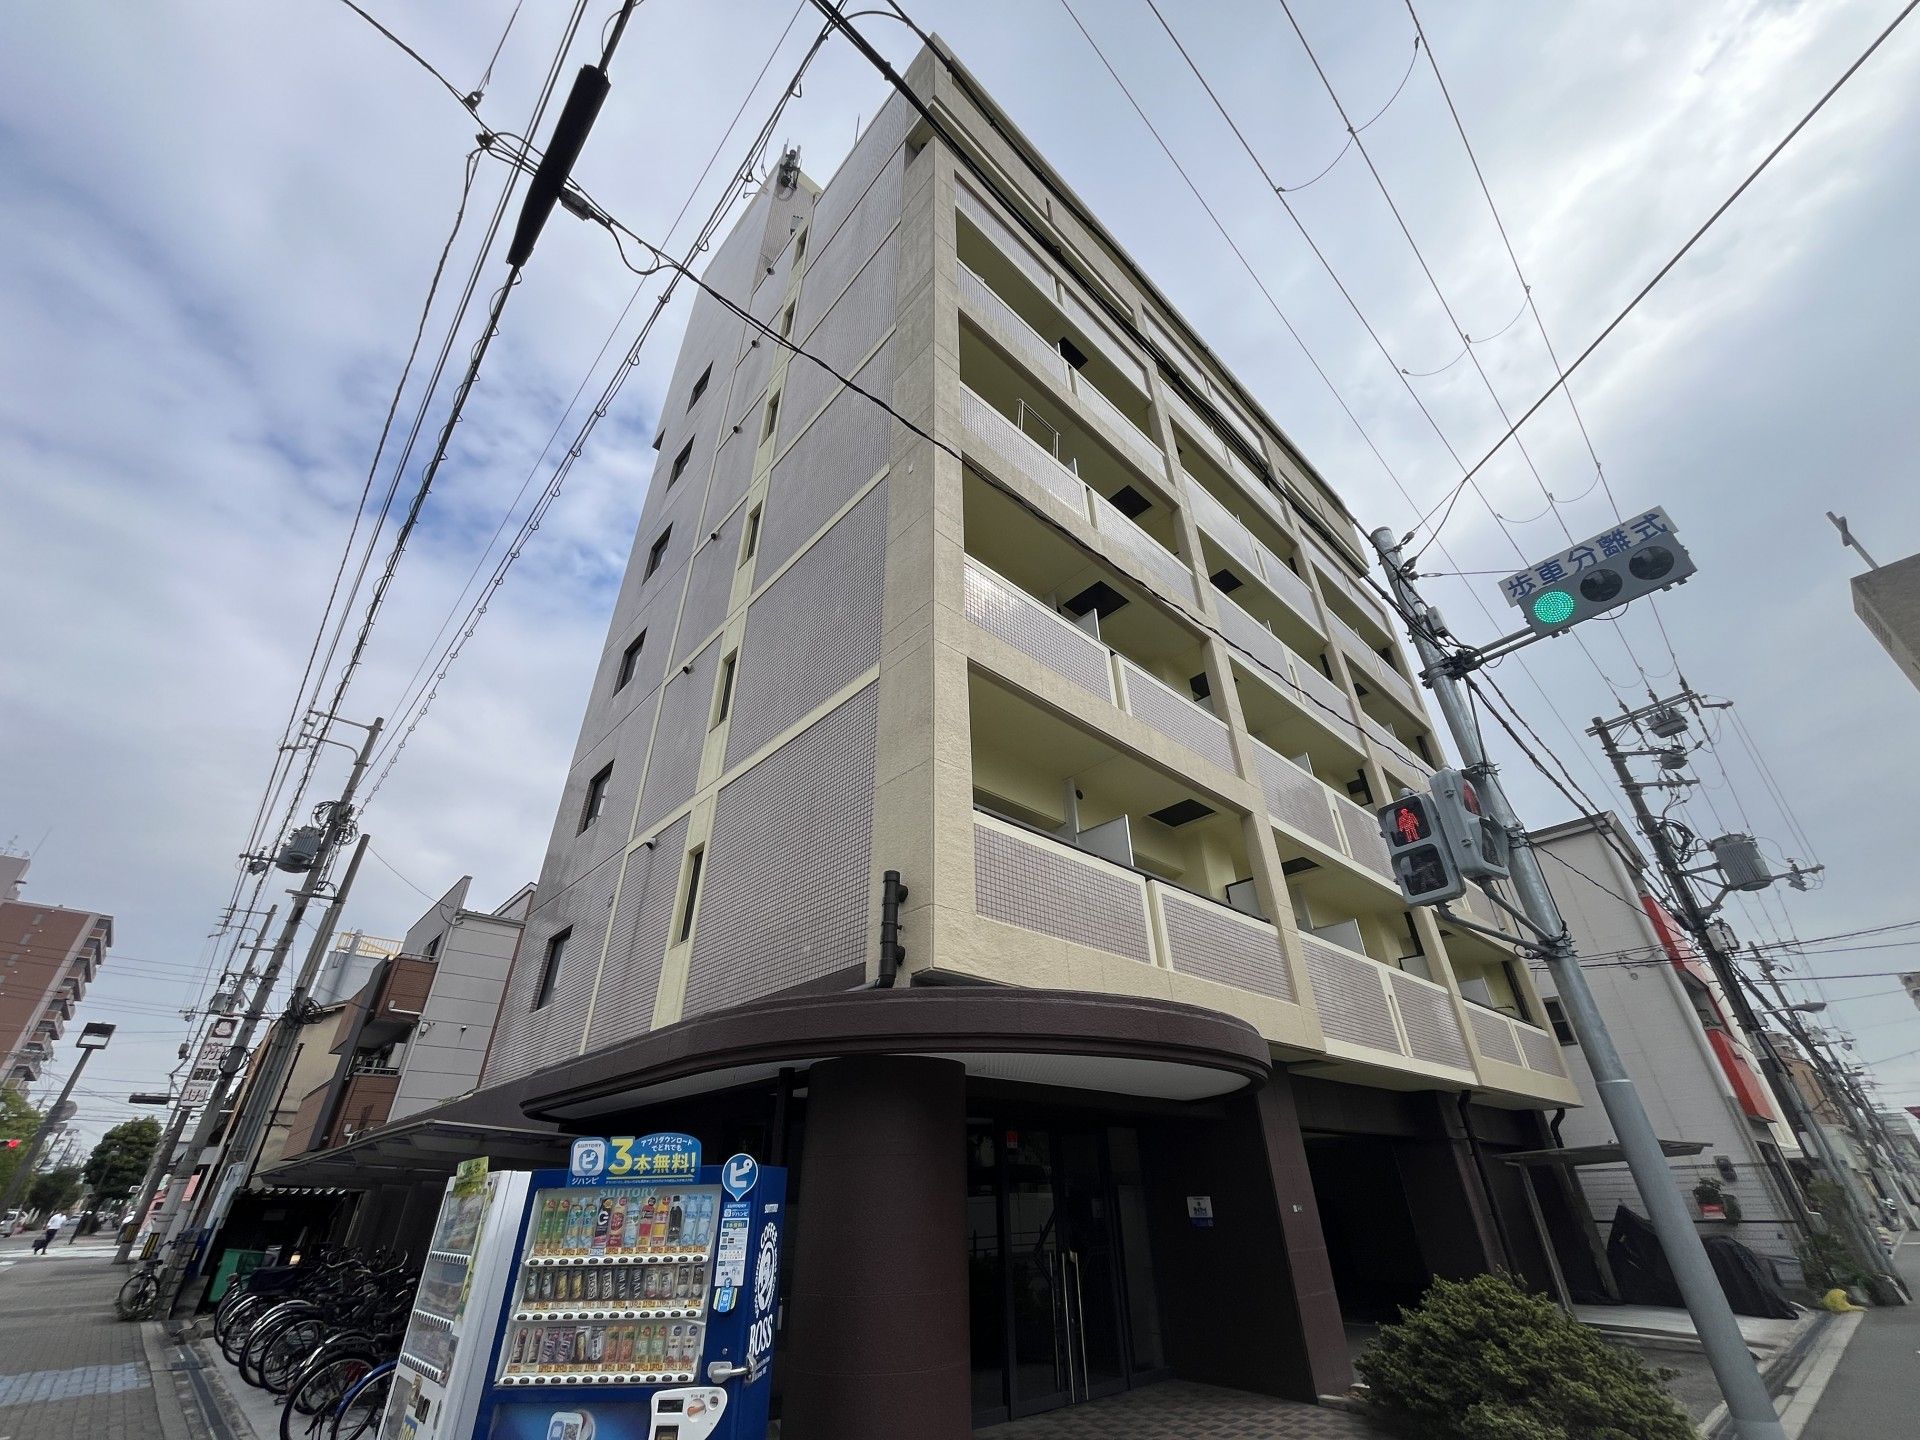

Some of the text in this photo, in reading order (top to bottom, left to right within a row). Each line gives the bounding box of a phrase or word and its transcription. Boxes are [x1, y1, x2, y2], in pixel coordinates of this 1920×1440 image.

[1507, 512, 1669, 598] 歩車分離式
[641, 1136, 693, 1147] アプリダウンロード
[651, 1144, 683, 1152] でどれでも
[608, 1138, 697, 1175] 3本無料!
[729, 1159, 753, 1188] ピ
[599, 1187, 657, 1198] SUNTORY
[748, 1313, 773, 1357] BOSS
